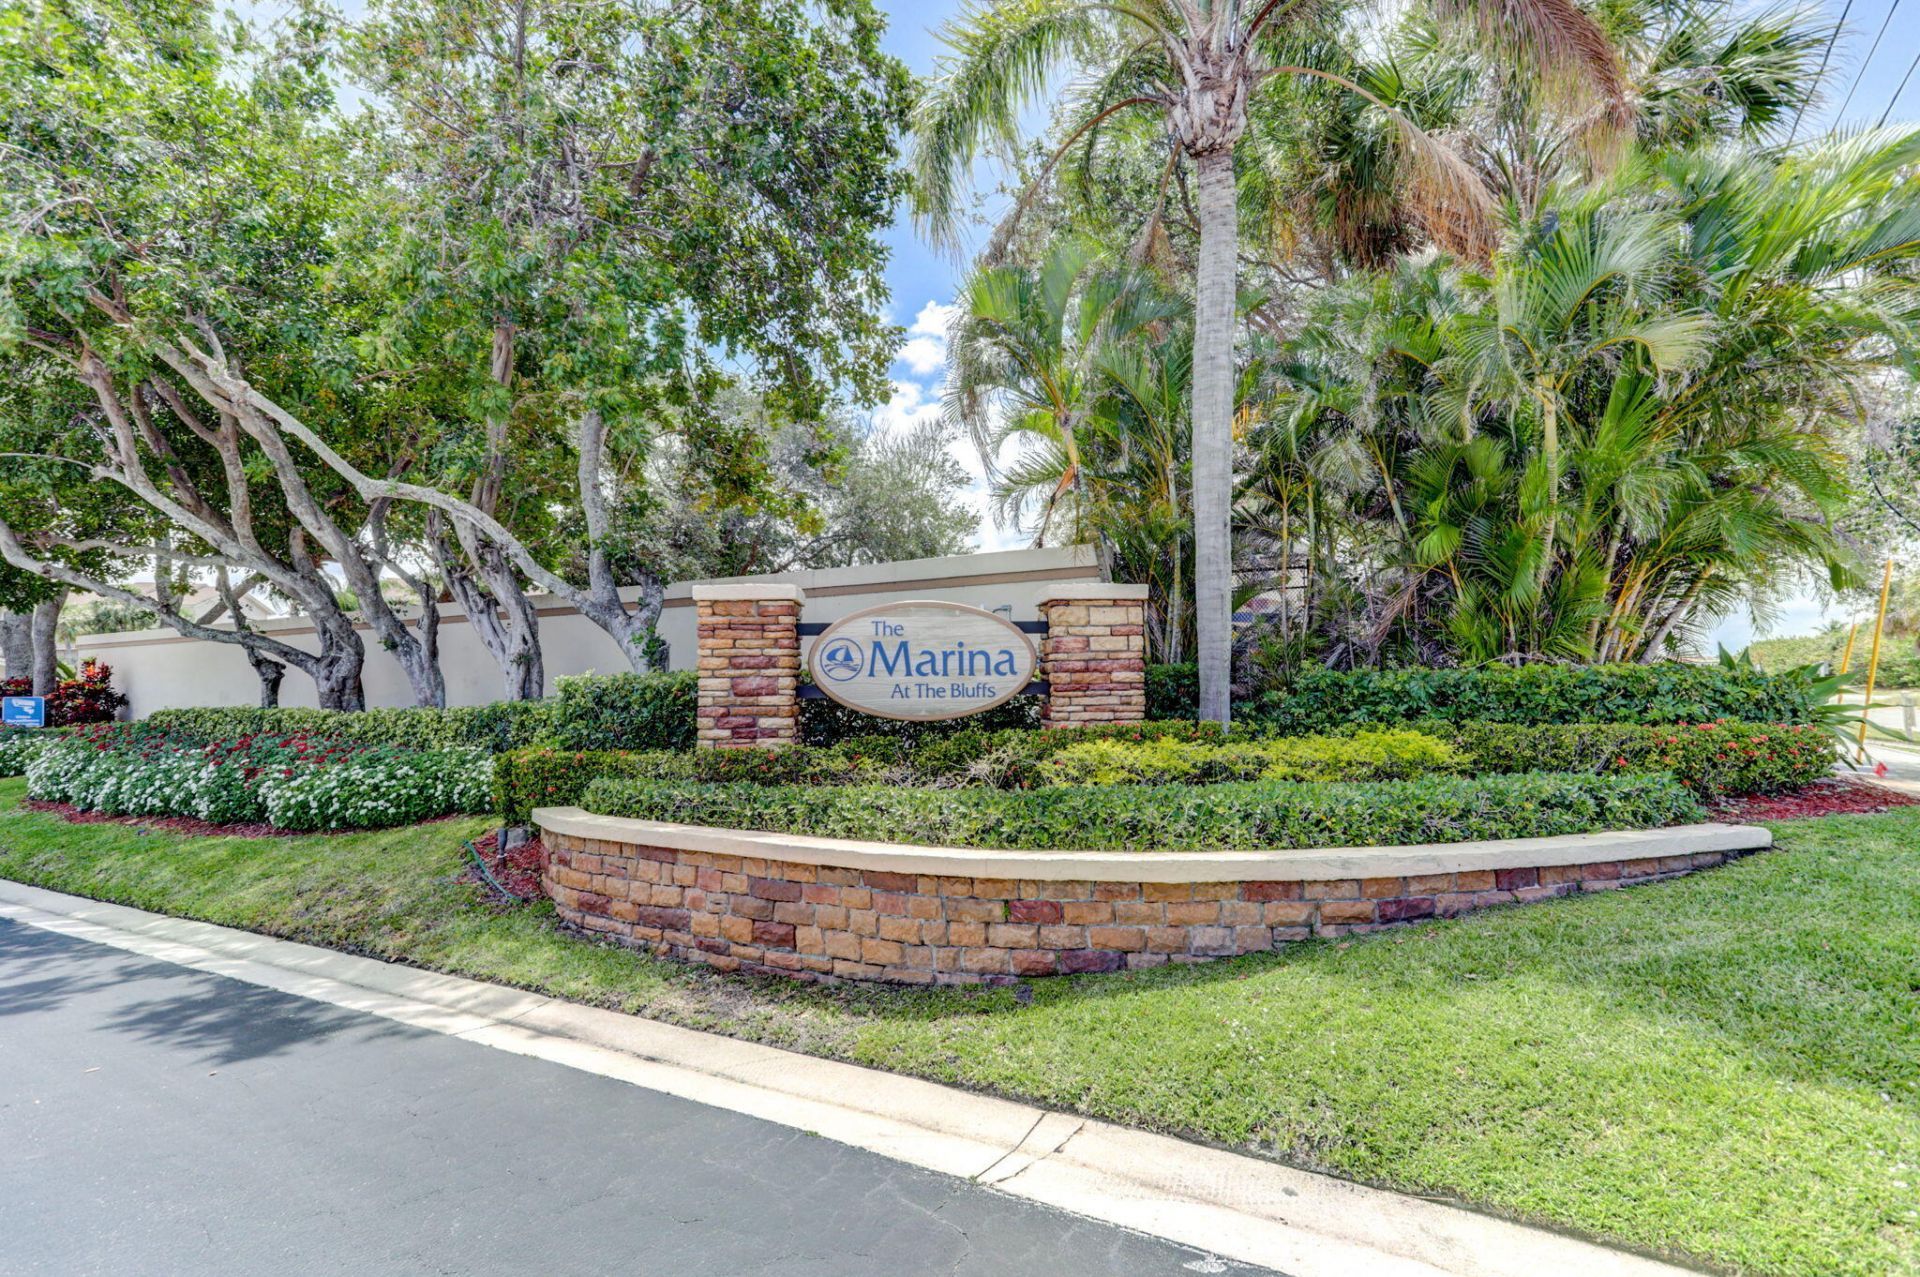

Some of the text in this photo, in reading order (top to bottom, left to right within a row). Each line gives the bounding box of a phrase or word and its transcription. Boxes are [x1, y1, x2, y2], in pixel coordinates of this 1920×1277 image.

[872, 620, 904, 636] The
[868, 641, 1018, 677] Marina
[891, 683, 996, 699] At The Bluffs
